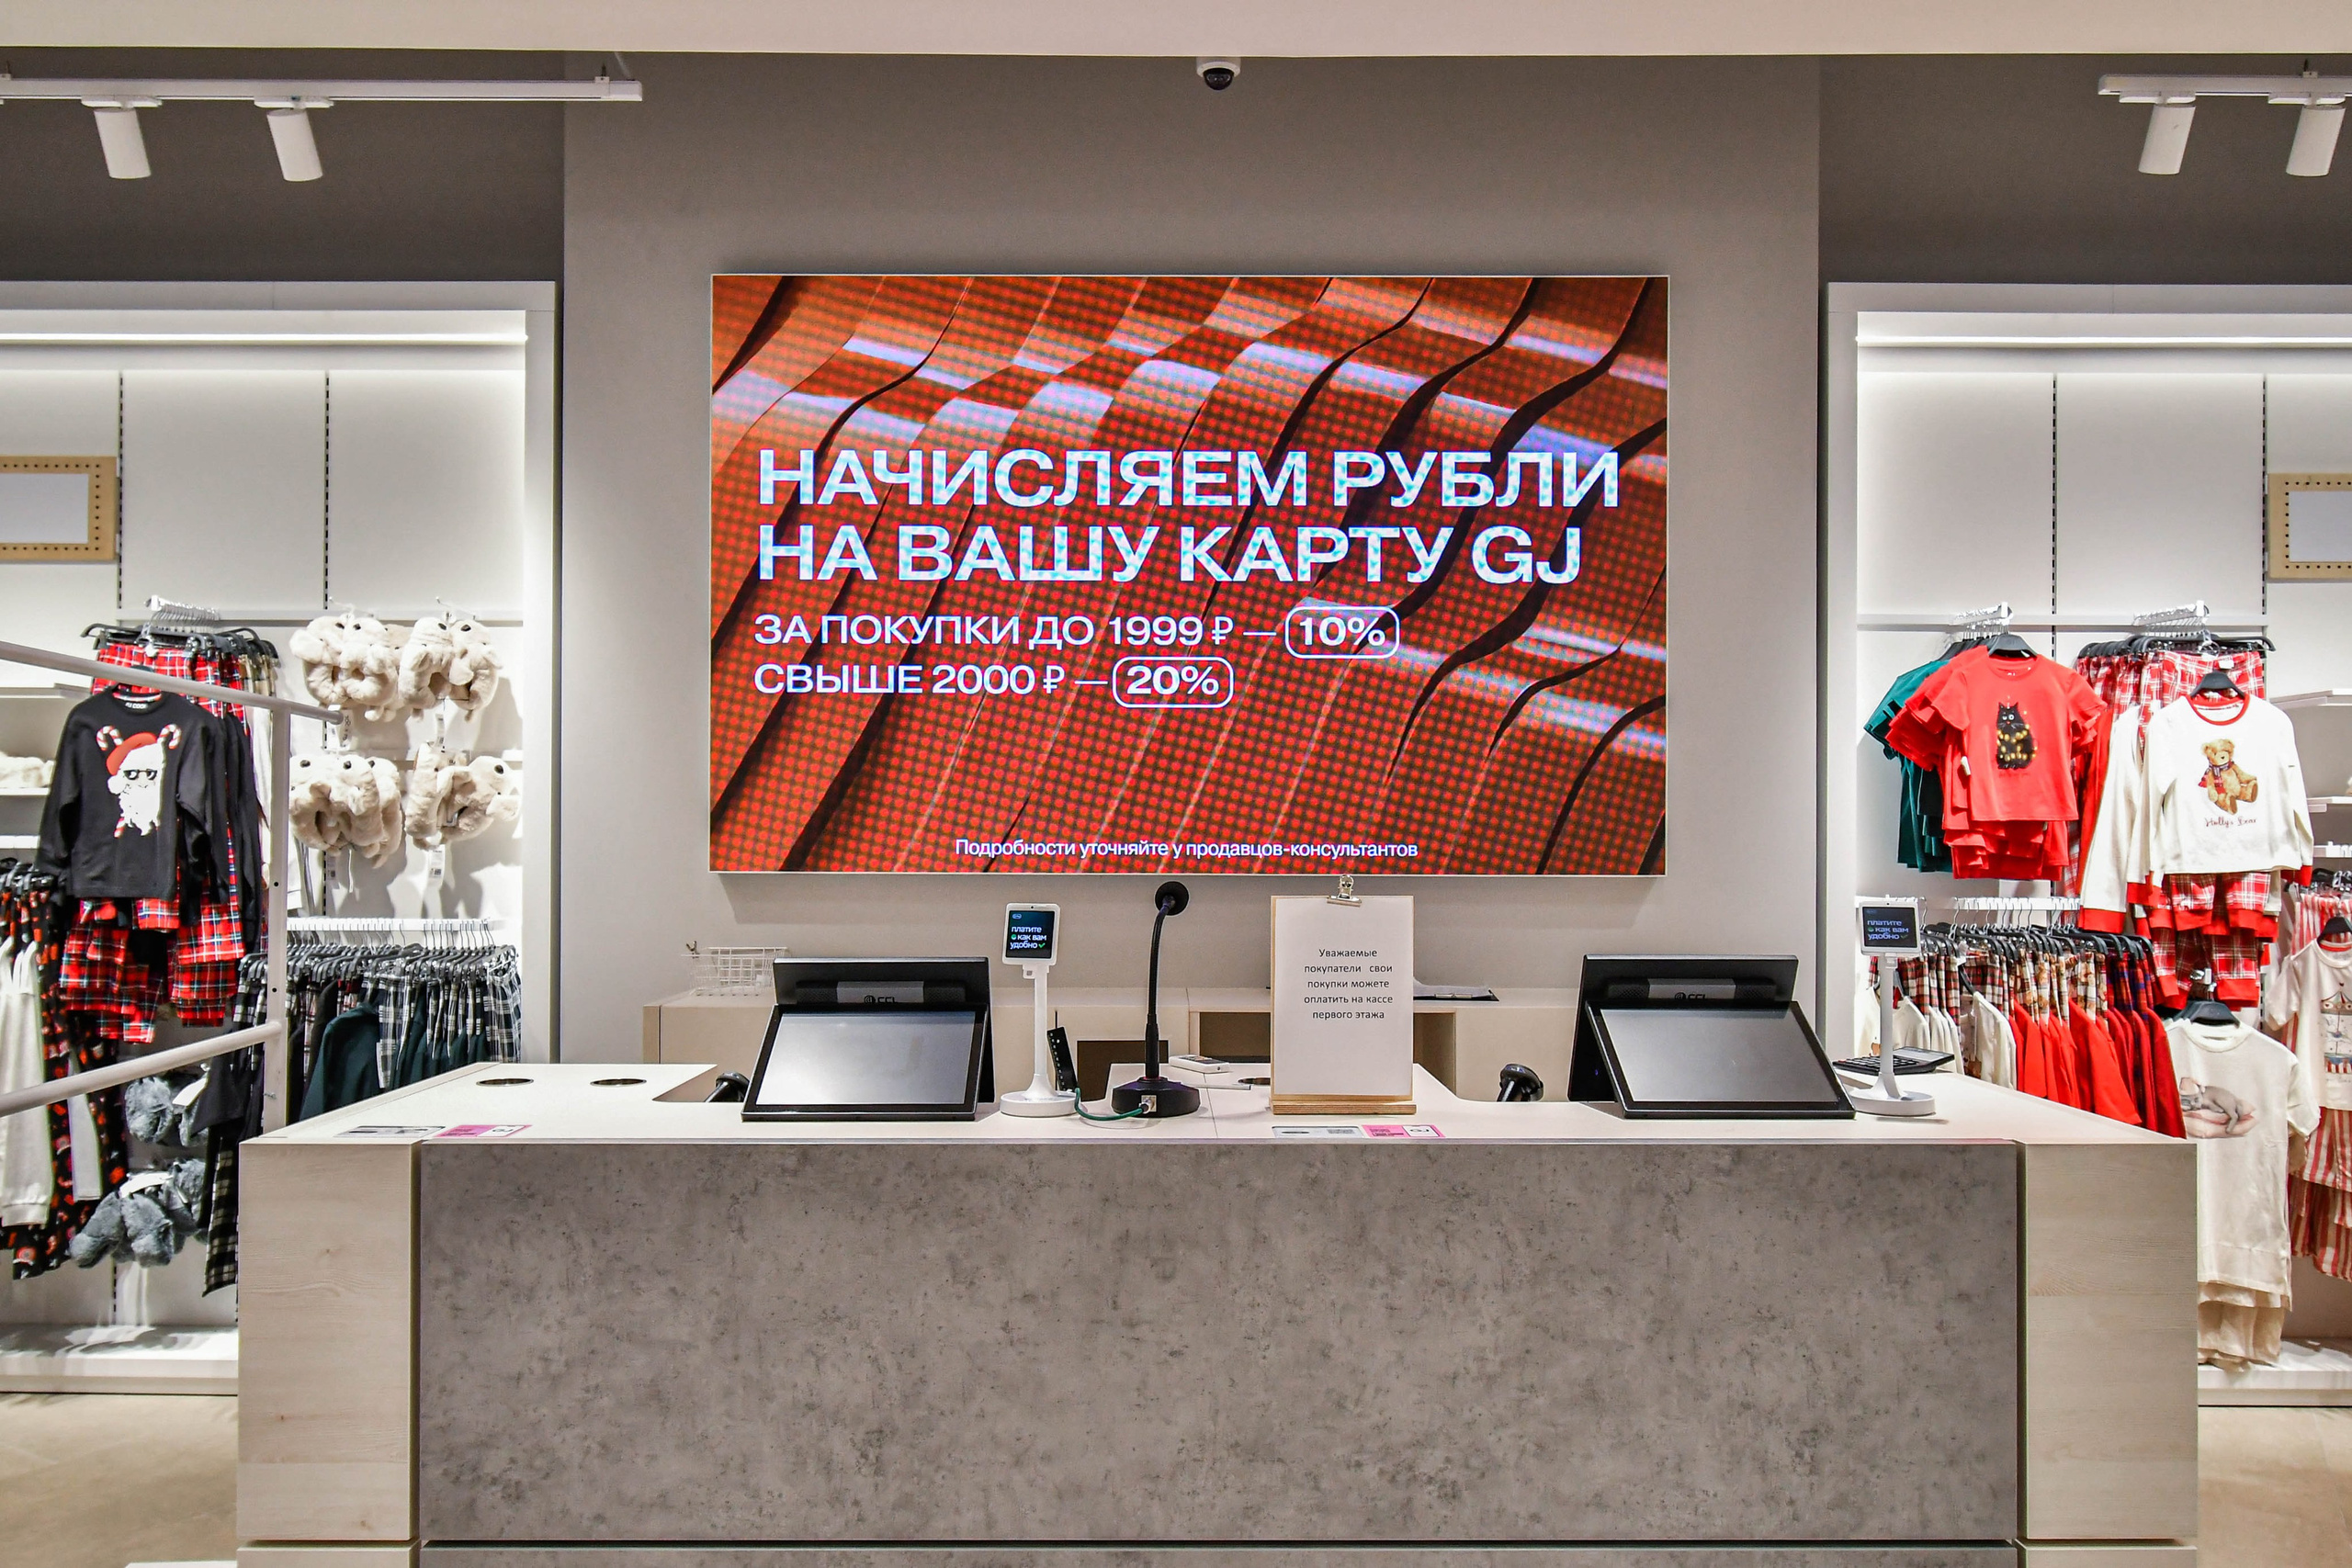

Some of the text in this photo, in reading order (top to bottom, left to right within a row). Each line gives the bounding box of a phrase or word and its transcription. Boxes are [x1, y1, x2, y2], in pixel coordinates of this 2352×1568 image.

[758, 448, 1619, 508] НАЧИСЛЯЕМ РУБЛИ
[759, 524, 1582, 585] НА ВАШУ КАРТУ GJ
[753, 614, 813, 645] ЗА
[820, 615, 1020, 646] ПОКУПКИ
[1028, 615, 1095, 650] ДО
[1108, 615, 1204, 647] 1999
[1298, 616, 1387, 647] 10%
[753, 663, 923, 695] СВЫШЕ
[932, 664, 1036, 695] 2000
[1125, 664, 1220, 695] 20%
[955, 839, 1419, 861] Подробности уточняйте у продавцов-консультантов
[1868, 931, 1900, 941] удобно
[1010, 940, 1038, 950] удобно
[1318, 949, 1378, 957] Уважаемые
[1304, 965, 1362, 975] покупатели
[1307, 980, 1390, 990] покупки можете
[1304, 996, 1394, 1004] оплатить на кассе
[1312, 1011, 1353, 1021] первого
